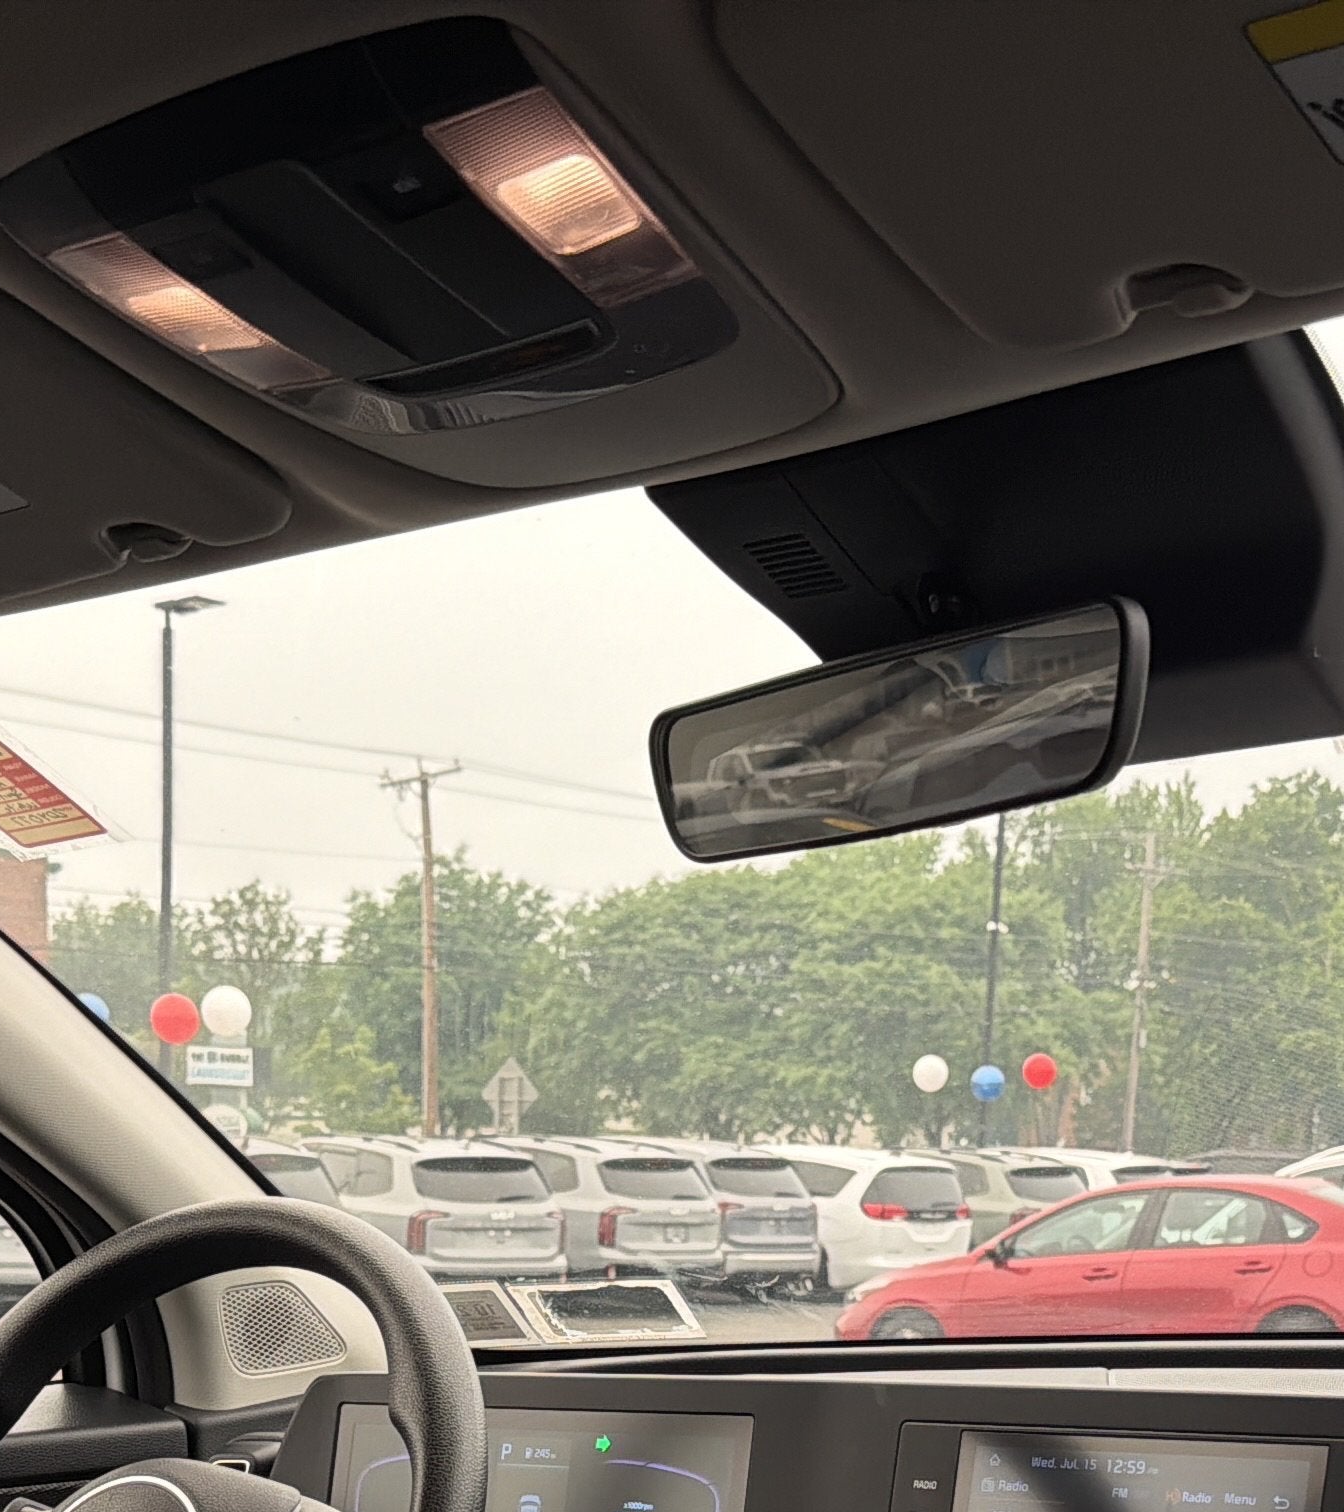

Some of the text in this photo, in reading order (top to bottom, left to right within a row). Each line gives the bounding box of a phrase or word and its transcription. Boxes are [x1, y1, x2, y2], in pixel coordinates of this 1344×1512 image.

[501, 1443, 513, 1460] P
[534, 1447, 551, 1459] 245
[1083, 1459, 1097, 1471] 15
[1105, 1458, 1147, 1475] 12:59
[913, 1479, 938, 1491] RADIO
[997, 1479, 1029, 1493] Radio
[1111, 1487, 1129, 1499] FM
[1182, 1491, 1212, 1505] Radio
[1224, 1492, 1257, 1506] Menu
